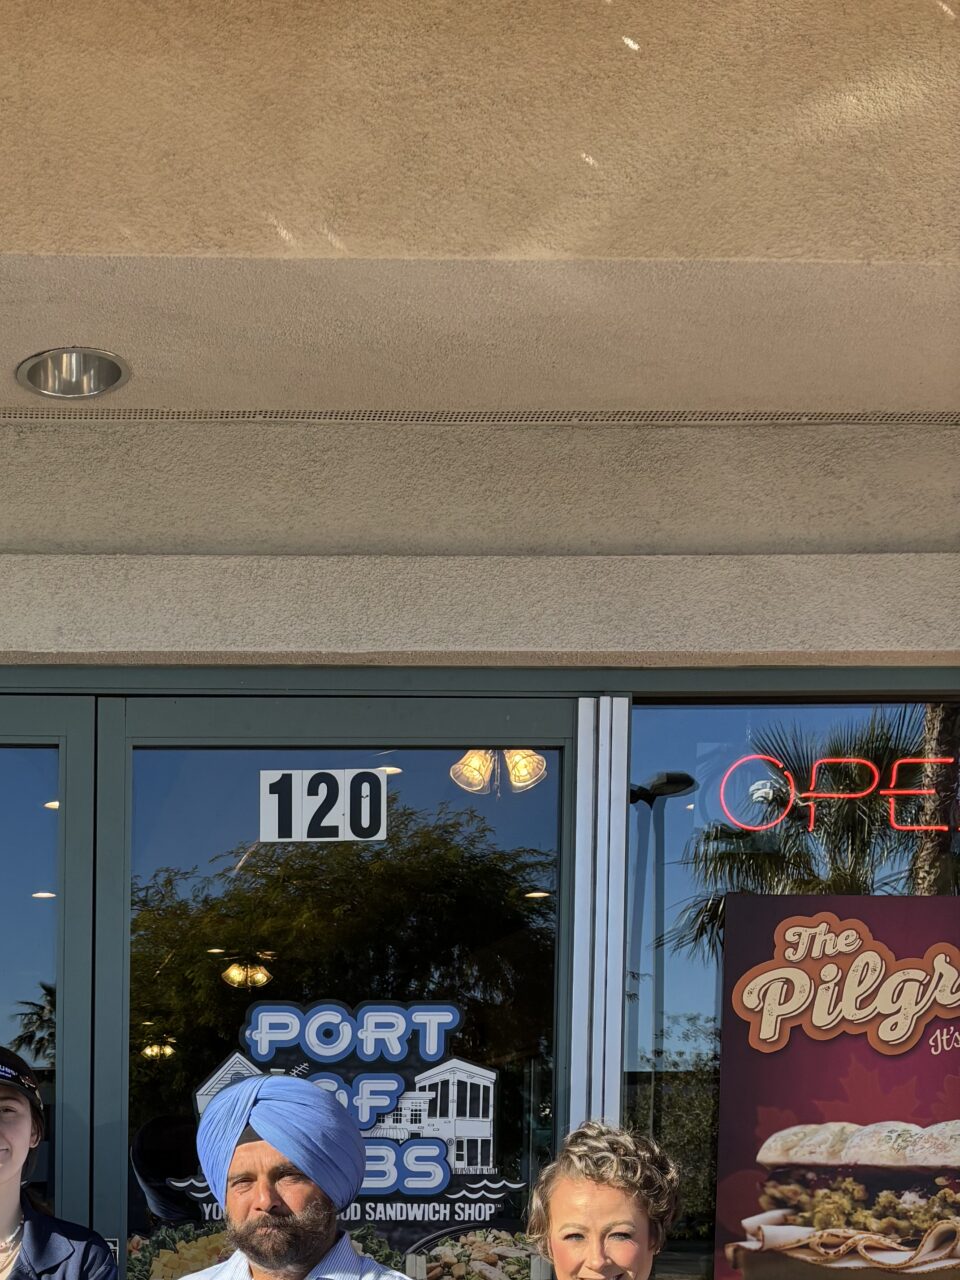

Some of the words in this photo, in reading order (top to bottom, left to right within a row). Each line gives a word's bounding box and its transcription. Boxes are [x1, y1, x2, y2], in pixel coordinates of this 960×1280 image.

[268, 771, 383, 839] 120
[720, 754, 960, 832] OPE
[784, 922, 863, 963] The
[251, 1010, 454, 1056] PORT
[365, 1202, 450, 1222] SANDWICH
[454, 1202, 495, 1221] SHOP
